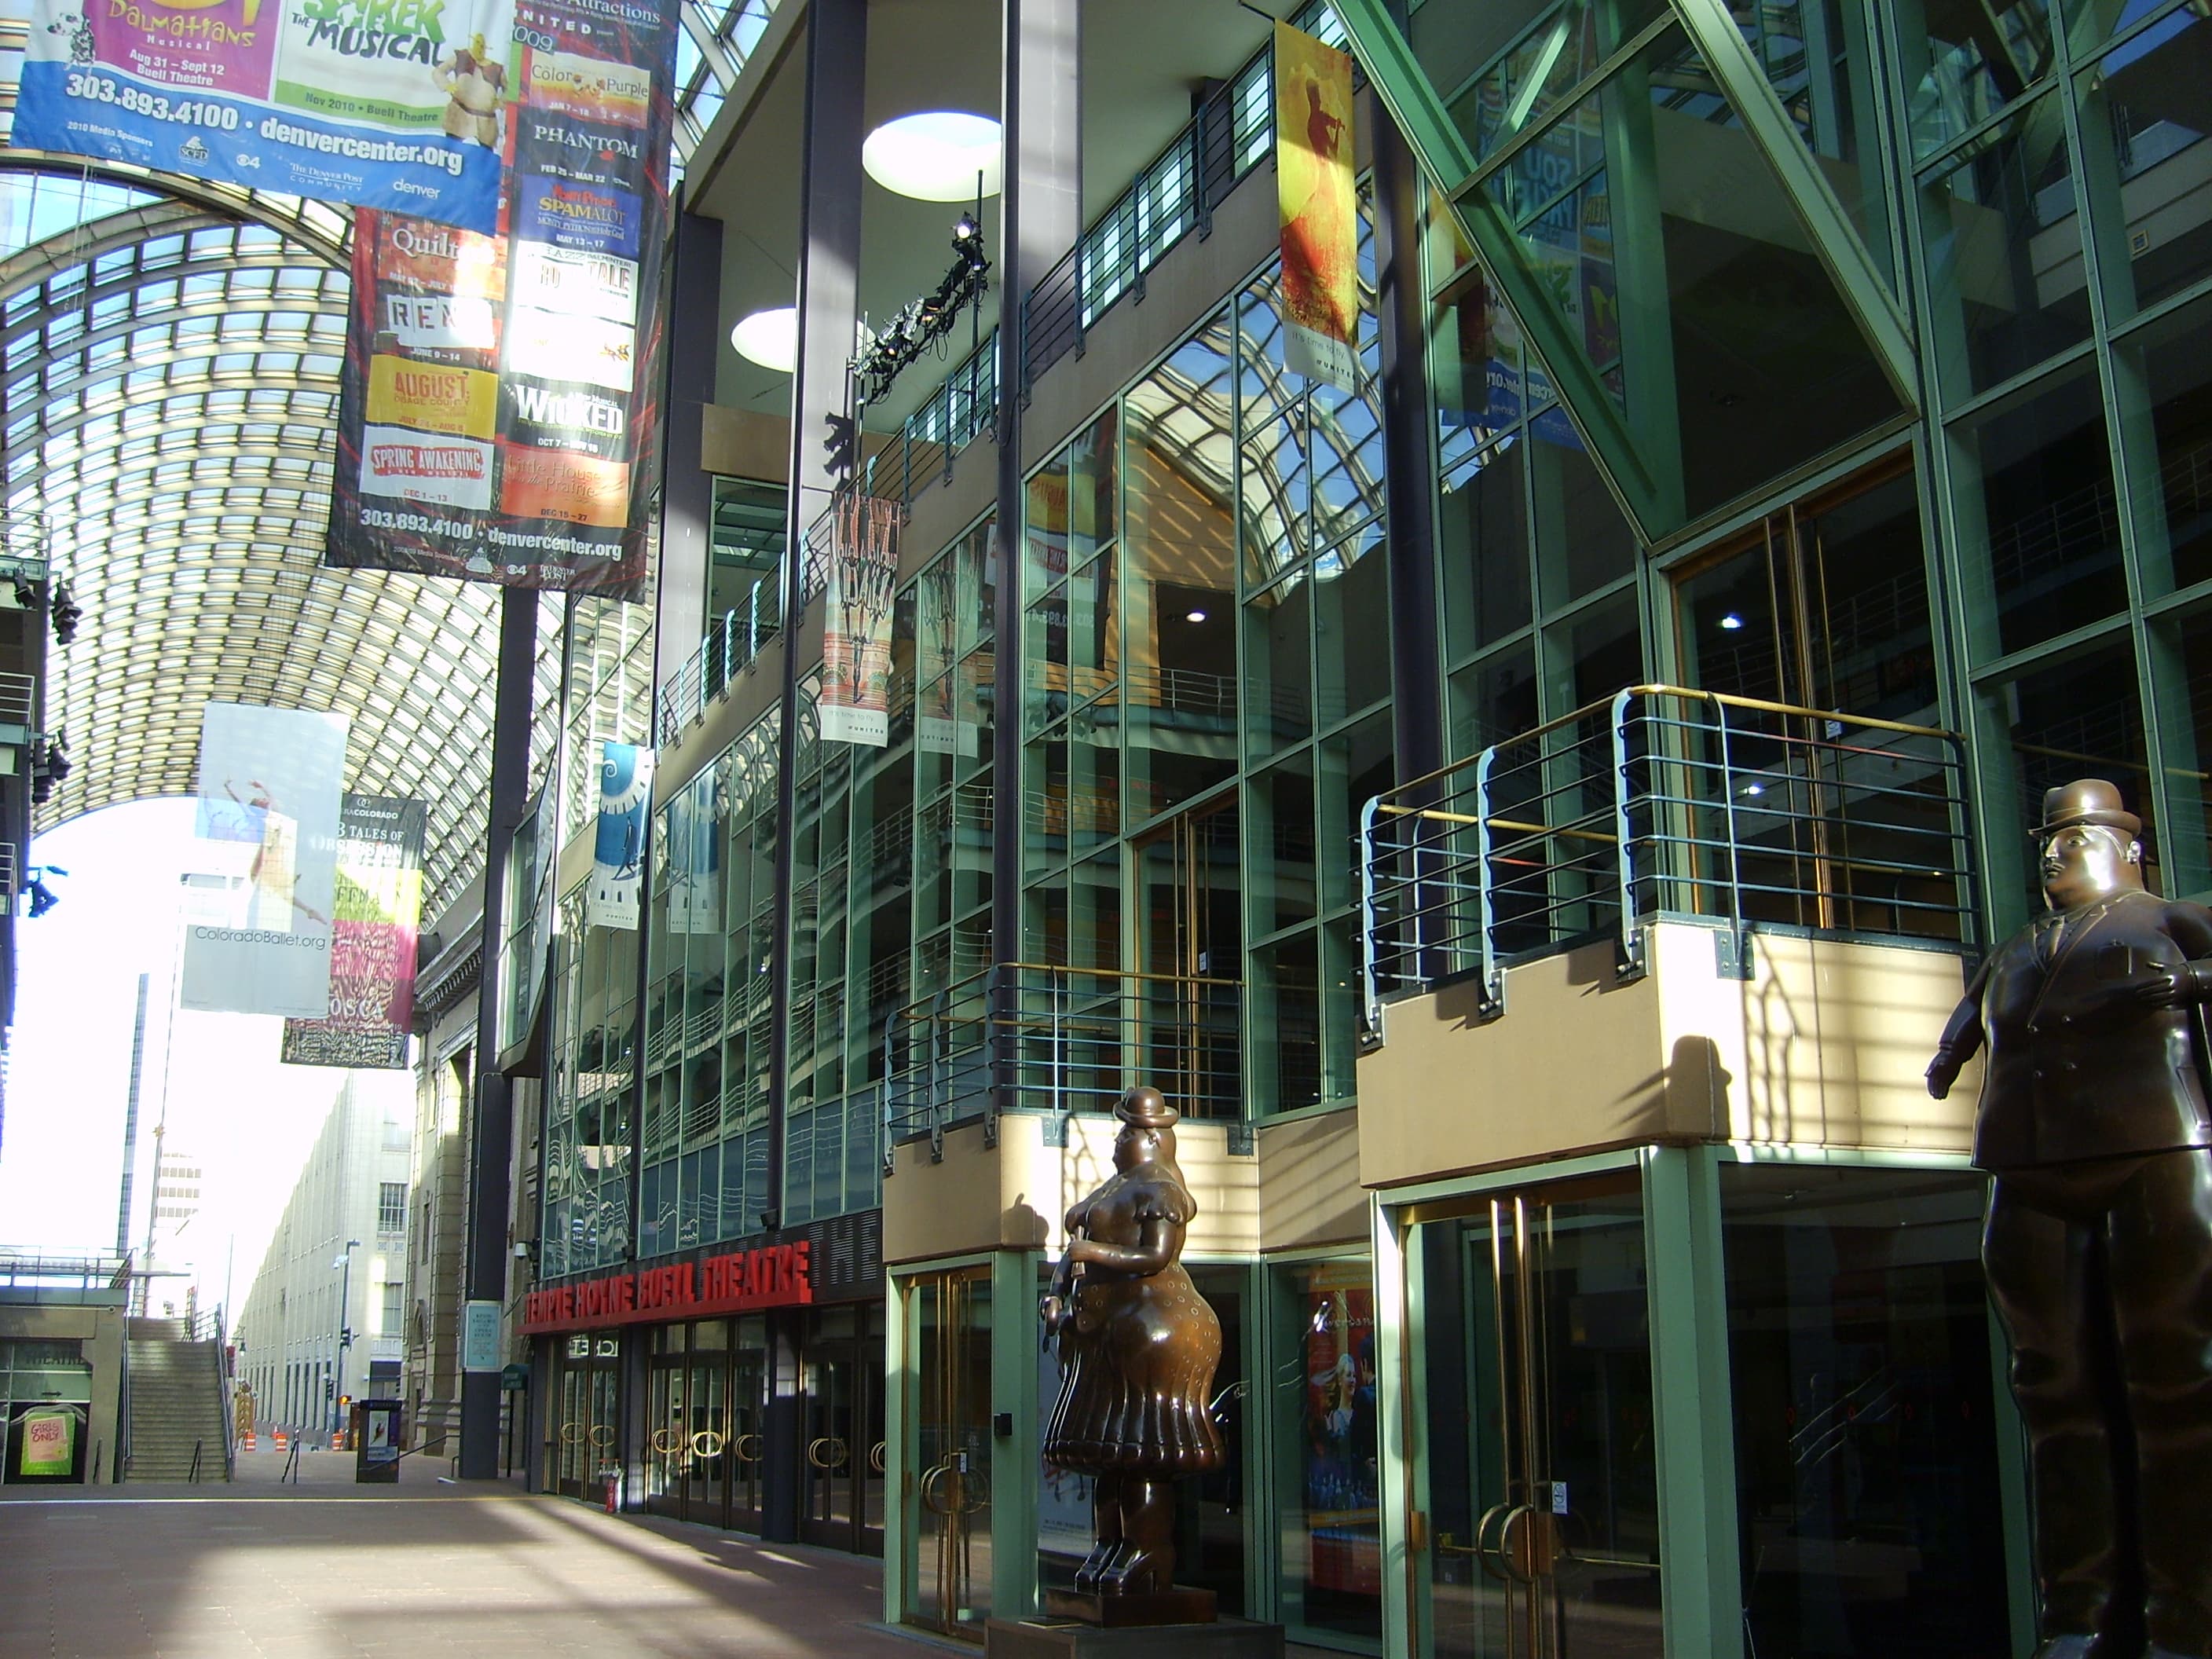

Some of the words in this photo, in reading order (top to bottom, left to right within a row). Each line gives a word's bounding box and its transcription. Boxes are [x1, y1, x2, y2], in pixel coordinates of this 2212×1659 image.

[515, 9, 591, 35] NITED
[307, 17, 445, 68] MUSICAL
[514, 26, 553, 52] 009
[129, 49, 149, 64] Aug
[153, 57, 167, 68] 31
[181, 60, 207, 74] Sept
[211, 63, 225, 75] 12
[137, 64, 167, 80] Buell
[170, 71, 214, 86] Theatre
[532, 64, 572, 82] Color
[606, 78, 648, 98] Purple
[306, 93, 325, 107] Nov
[328, 99, 354, 112] 2010
[367, 104, 395, 119] Buell
[398, 110, 438, 123] Theatre
[66, 73, 239, 130] 303.893.4100
[261, 117, 464, 177] denvercenter.org
[89, 123, 115, 137] Media
[117, 129, 154, 148] Sponsors
[534, 125, 638, 159] PHANTOM
[393, 178, 441, 199] denver
[539, 196, 626, 225] SPAMALOT
[595, 239, 605, 248] 17
[515, 384, 623, 434] WICKED
[538, 437, 555, 447] OCT
[372, 448, 414, 469] SPRING
[419, 449, 482, 471] AWAKENING
[437, 493, 448, 502] 13
[360, 508, 472, 540] 303.893.4100
[488, 526, 623, 562] denvercenter.org
[349, 825, 387, 840] TALES
[390, 830, 404, 841] OF
[196, 926, 326, 950] ColoradoBallet.org
[637, 1262, 696, 1309] BUELL
[704, 1240, 811, 1299] THEATRE
[32, 1432, 60, 1443] ONLY
